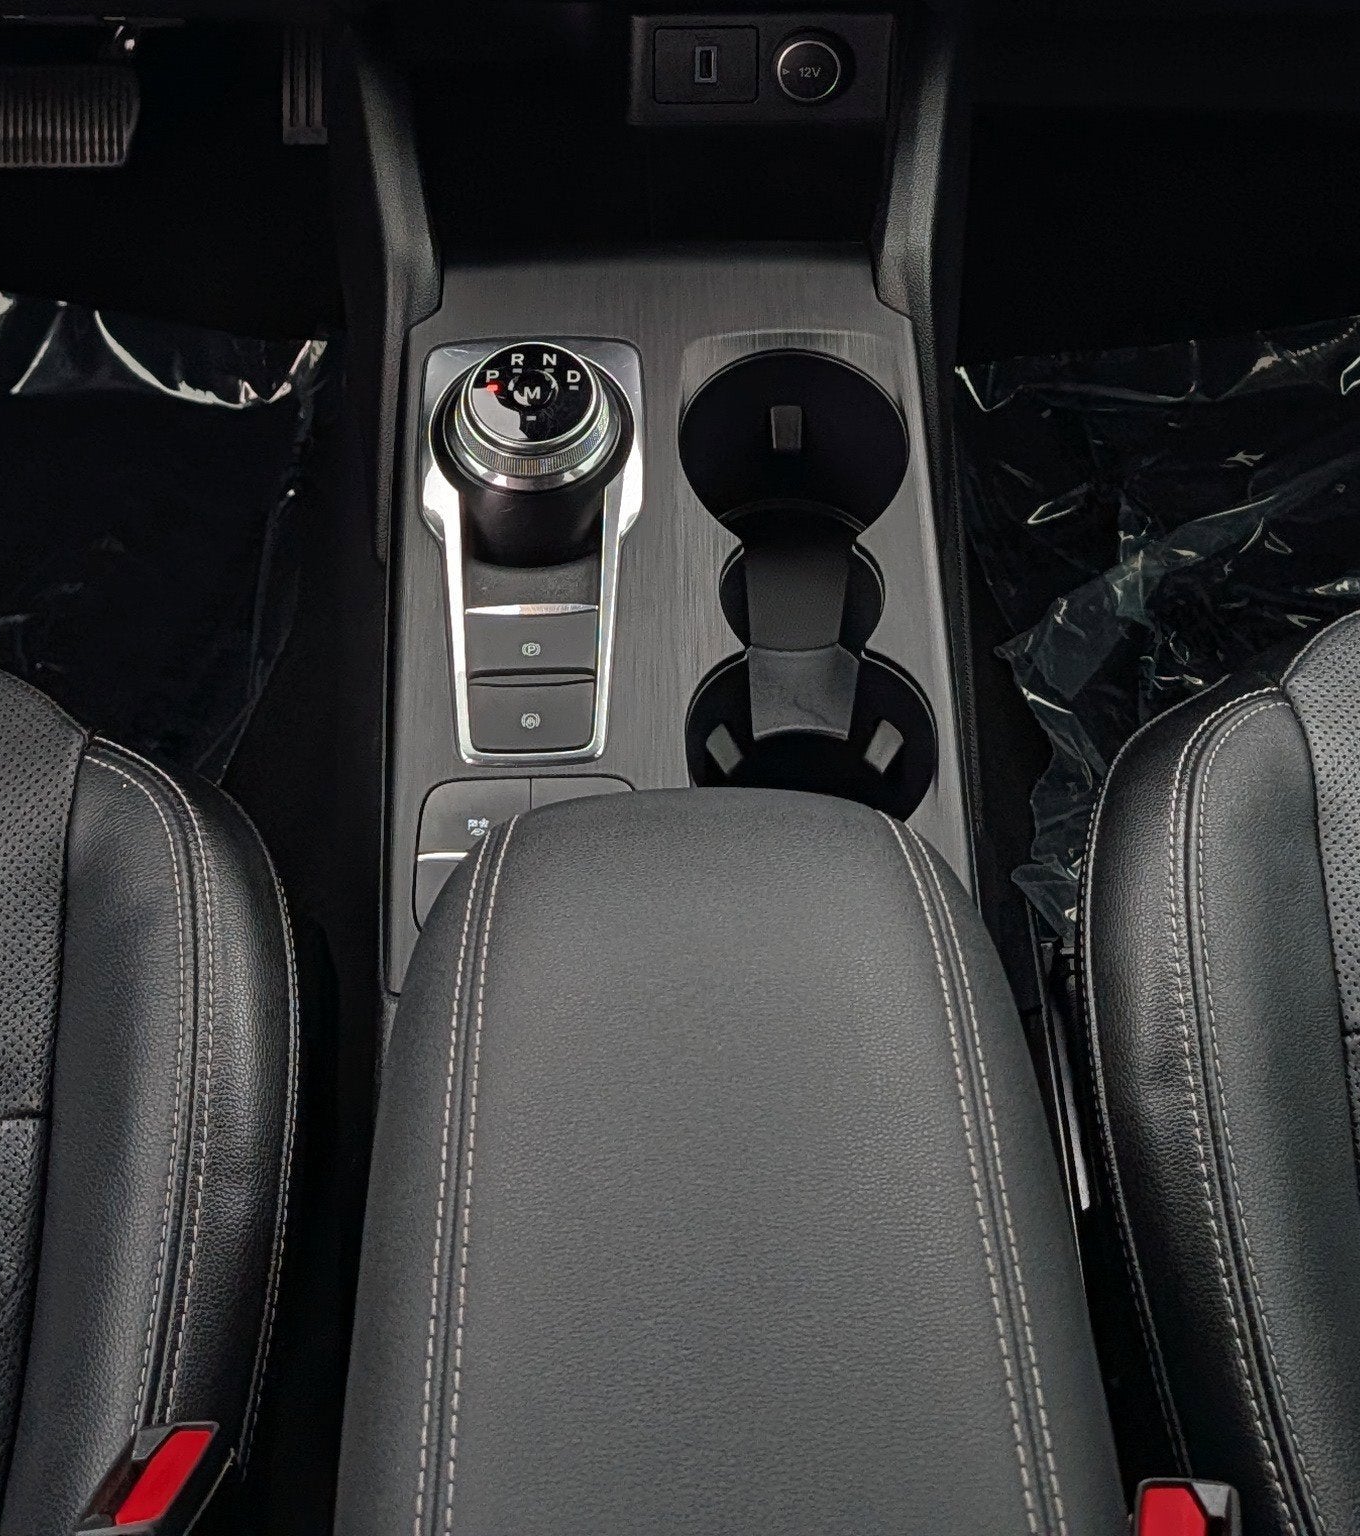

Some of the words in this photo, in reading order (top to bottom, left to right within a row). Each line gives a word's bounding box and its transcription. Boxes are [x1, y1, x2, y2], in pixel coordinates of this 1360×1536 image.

[799, 67, 821, 78] 12V
[510, 353, 525, 366] R
[542, 353, 557, 366] N
[486, 369, 500, 383] P
[566, 369, 581, 383] D
[524, 386, 541, 400] M
